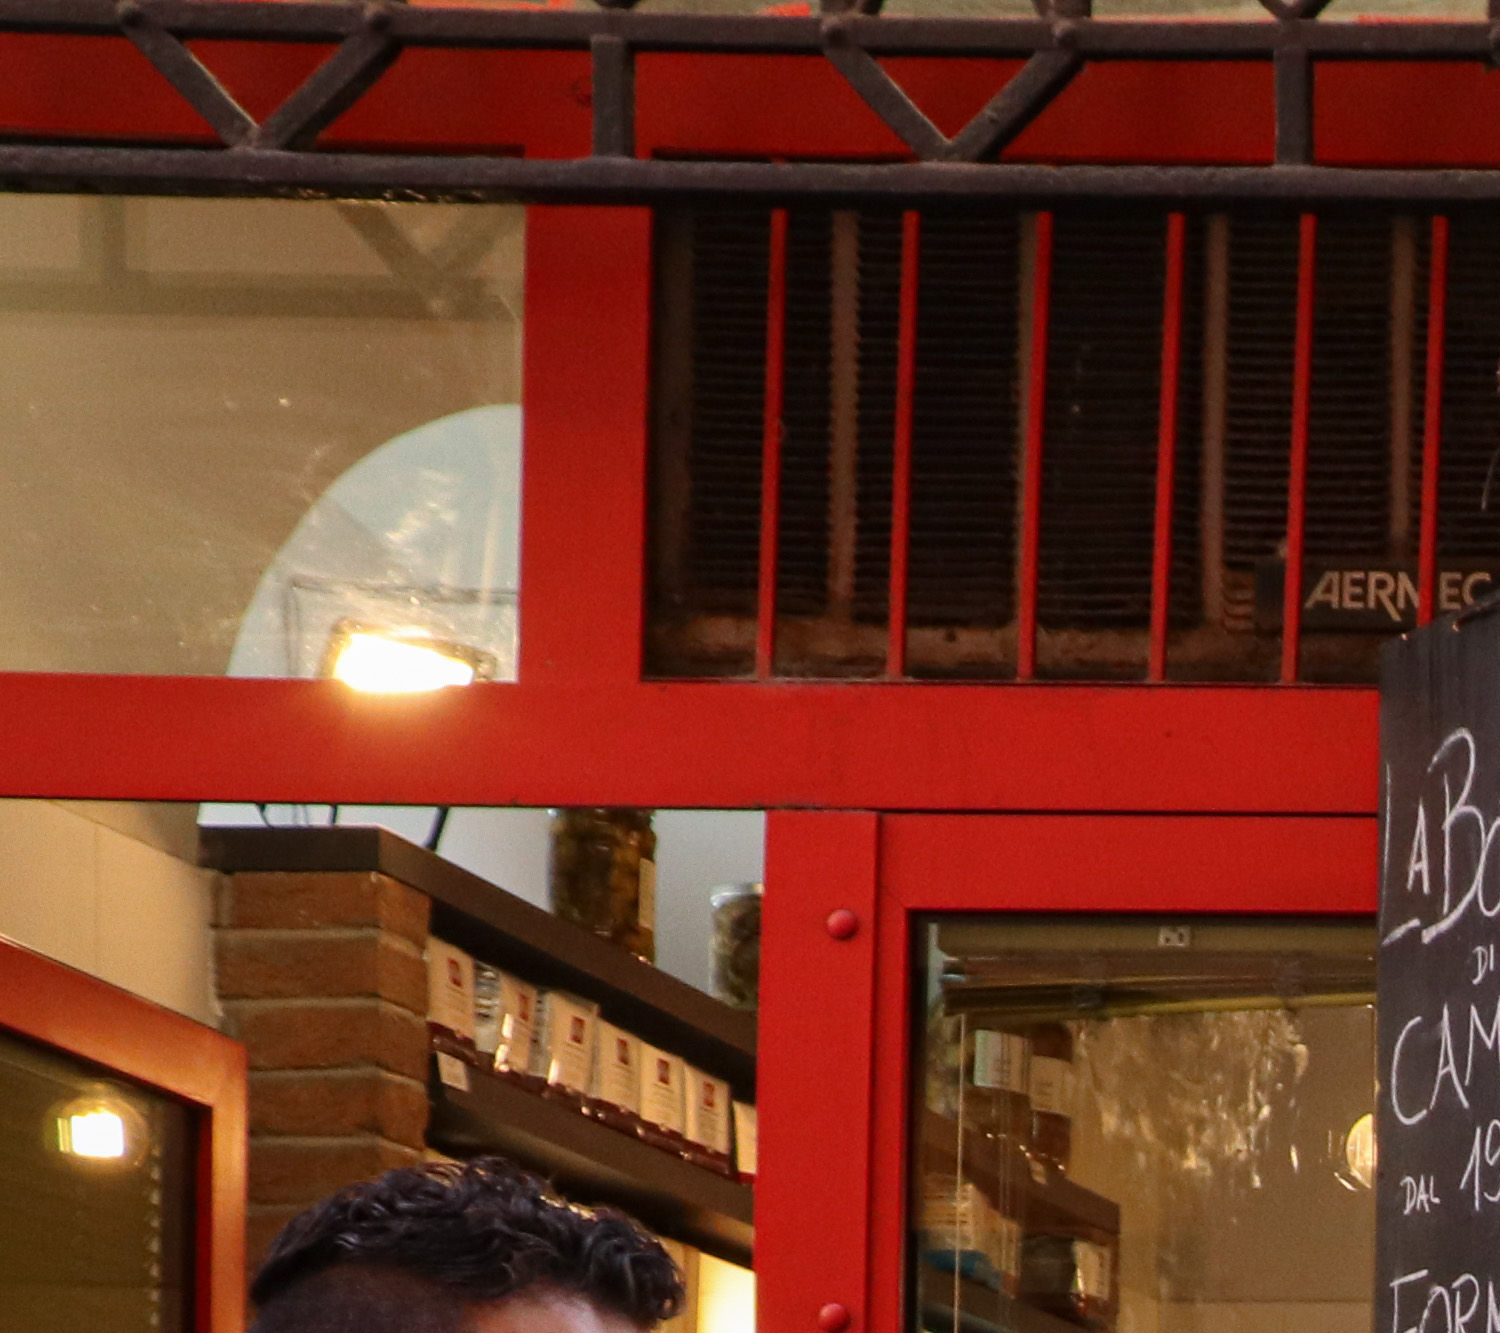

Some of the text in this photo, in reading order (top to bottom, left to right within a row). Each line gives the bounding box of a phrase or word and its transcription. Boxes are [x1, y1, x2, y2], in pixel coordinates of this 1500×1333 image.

[1380, 763, 1431, 946] LA
[1472, 943, 1495, 985] DI
[1401, 1174, 1440, 1215] DAL
